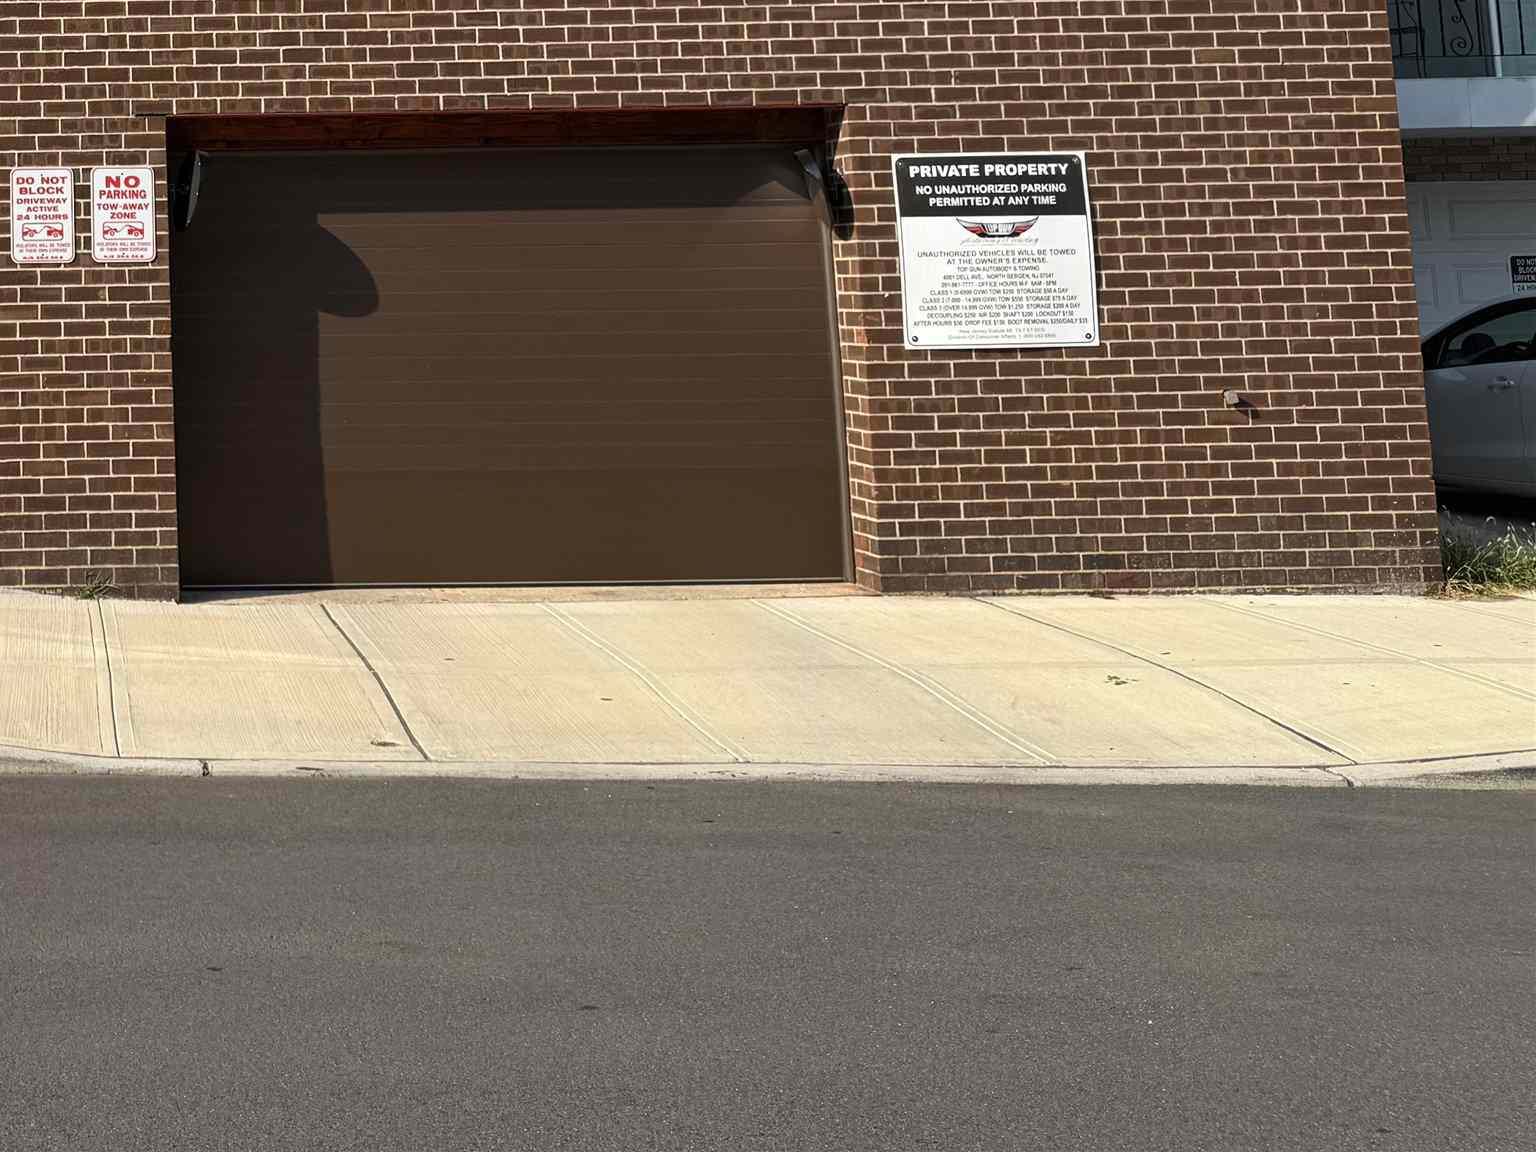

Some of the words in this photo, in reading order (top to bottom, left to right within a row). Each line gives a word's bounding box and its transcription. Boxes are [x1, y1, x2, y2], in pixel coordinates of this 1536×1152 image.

[909, 164, 980, 178] PRIVATE
[984, 163, 1068, 176] PROPERTY
[16, 176, 34, 185] DO
[41, 176, 68, 185] NOT
[105, 175, 140, 188] NO
[19, 187, 64, 195] BLOCK
[915, 185, 933, 195] NO
[934, 184, 1018, 195] UNAUTHORIZED
[1021, 183, 1067, 193] PARKING
[99, 190, 147, 199] PARKING
[929, 197, 990, 207] PERMITTED
[992, 196, 1005, 206] AT
[1008, 196, 1030, 206] ANY
[1032, 195, 1057, 205] TIME
[1516, 258, 1525, 266] DO
